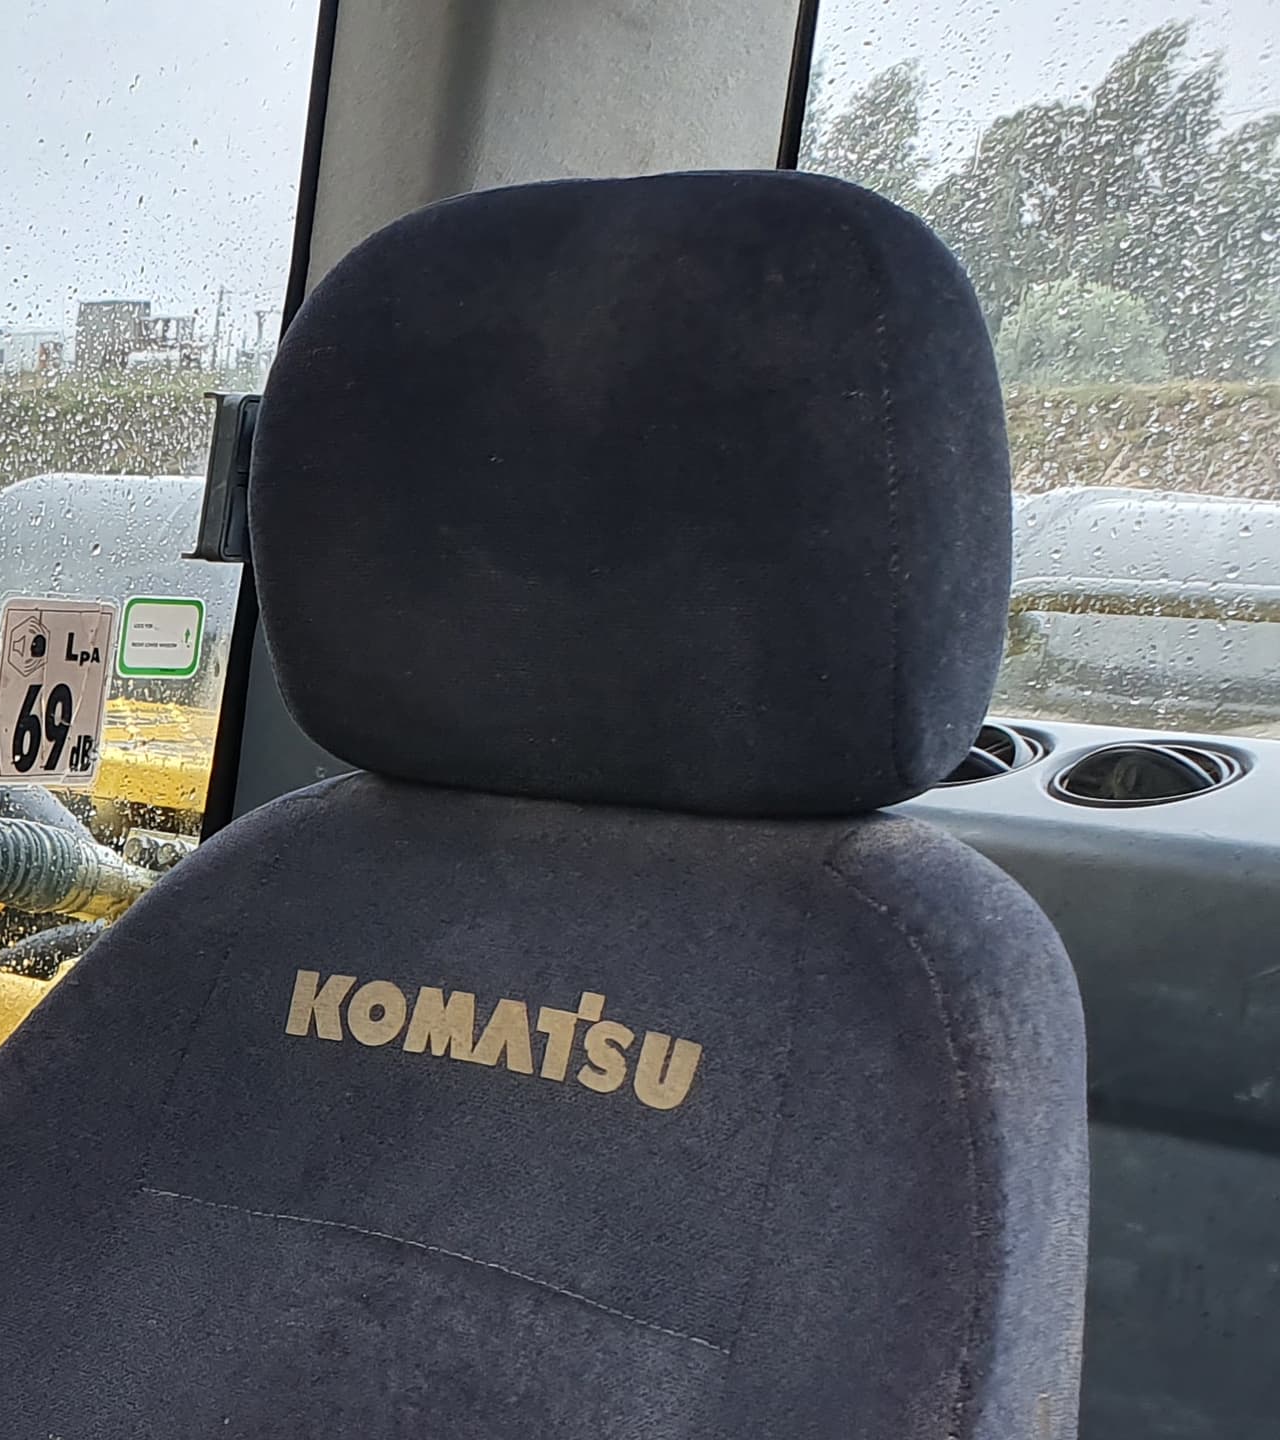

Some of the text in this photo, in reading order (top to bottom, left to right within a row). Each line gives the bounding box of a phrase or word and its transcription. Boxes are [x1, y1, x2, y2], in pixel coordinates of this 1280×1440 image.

[12, 683, 93, 773] 69 dB
[285, 969, 703, 1111] KOMATSU
